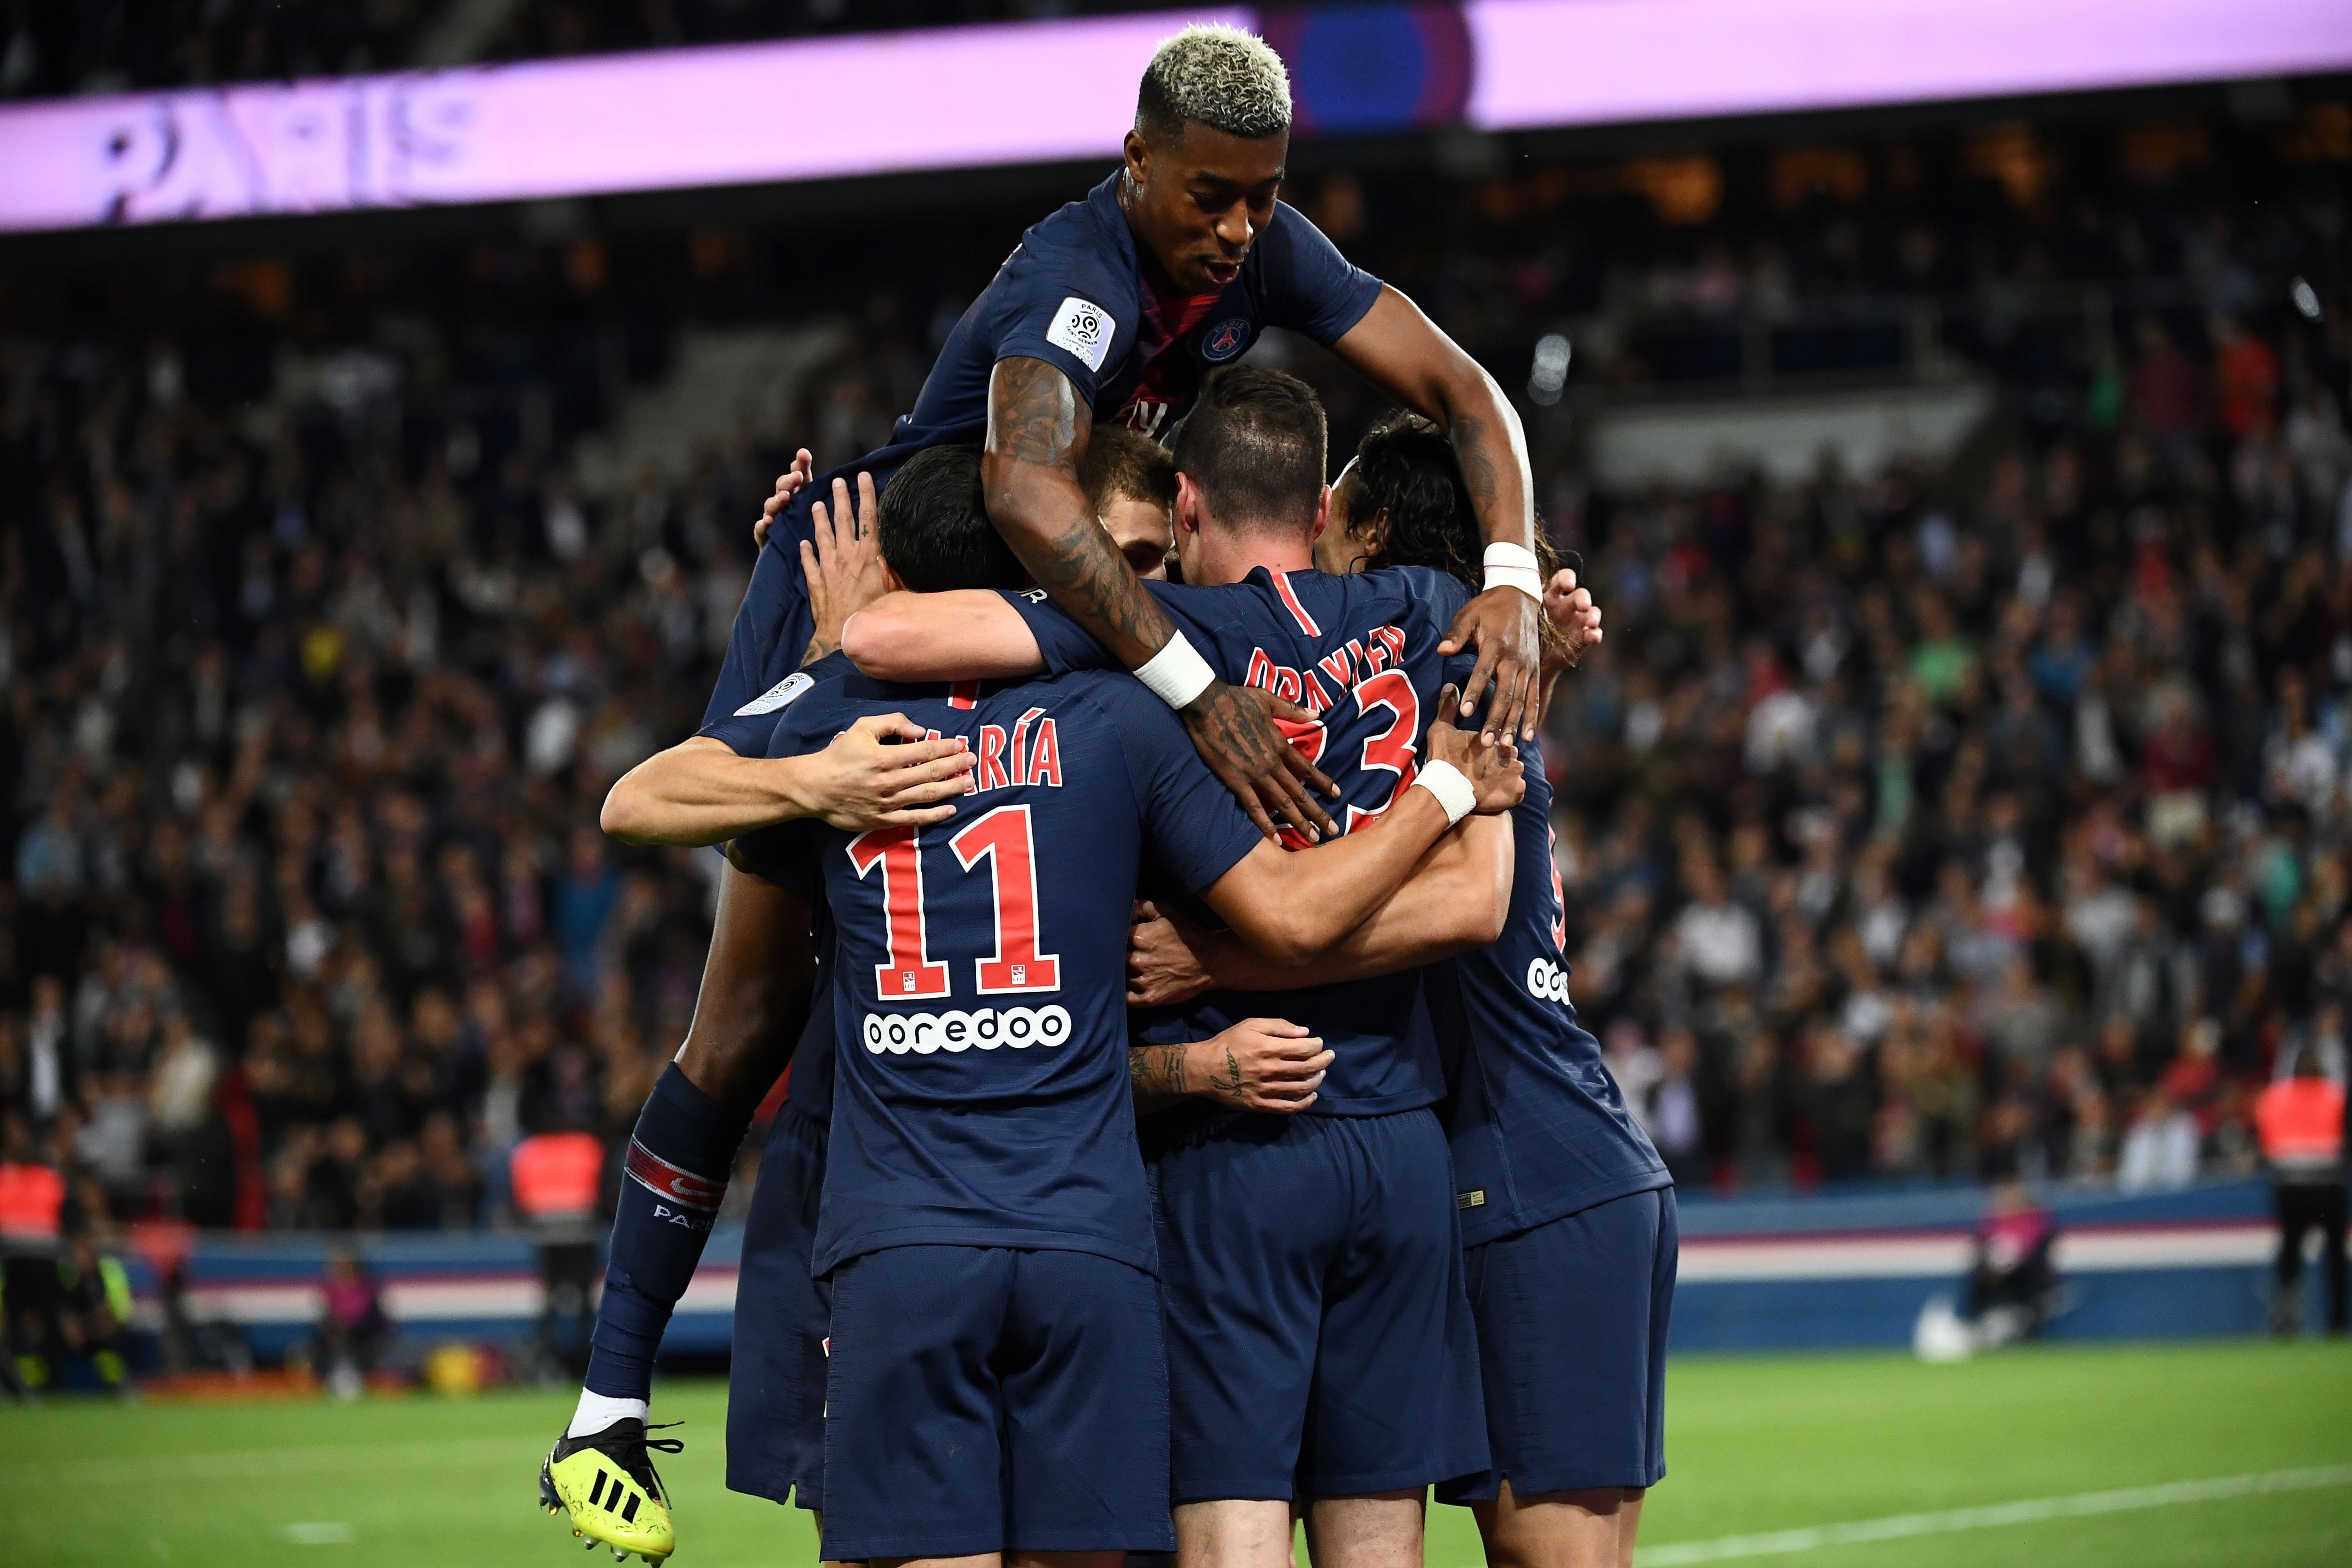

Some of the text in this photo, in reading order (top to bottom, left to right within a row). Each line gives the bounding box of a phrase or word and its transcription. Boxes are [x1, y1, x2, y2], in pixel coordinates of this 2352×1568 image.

[100, 81, 477, 224] PARIS
[1082, 304, 1103, 318] PARIS
[1215, 321, 1245, 332] PARIS
[846, 804, 1061, 1000] 11
[866, 1007, 1069, 1051] ooredoo
